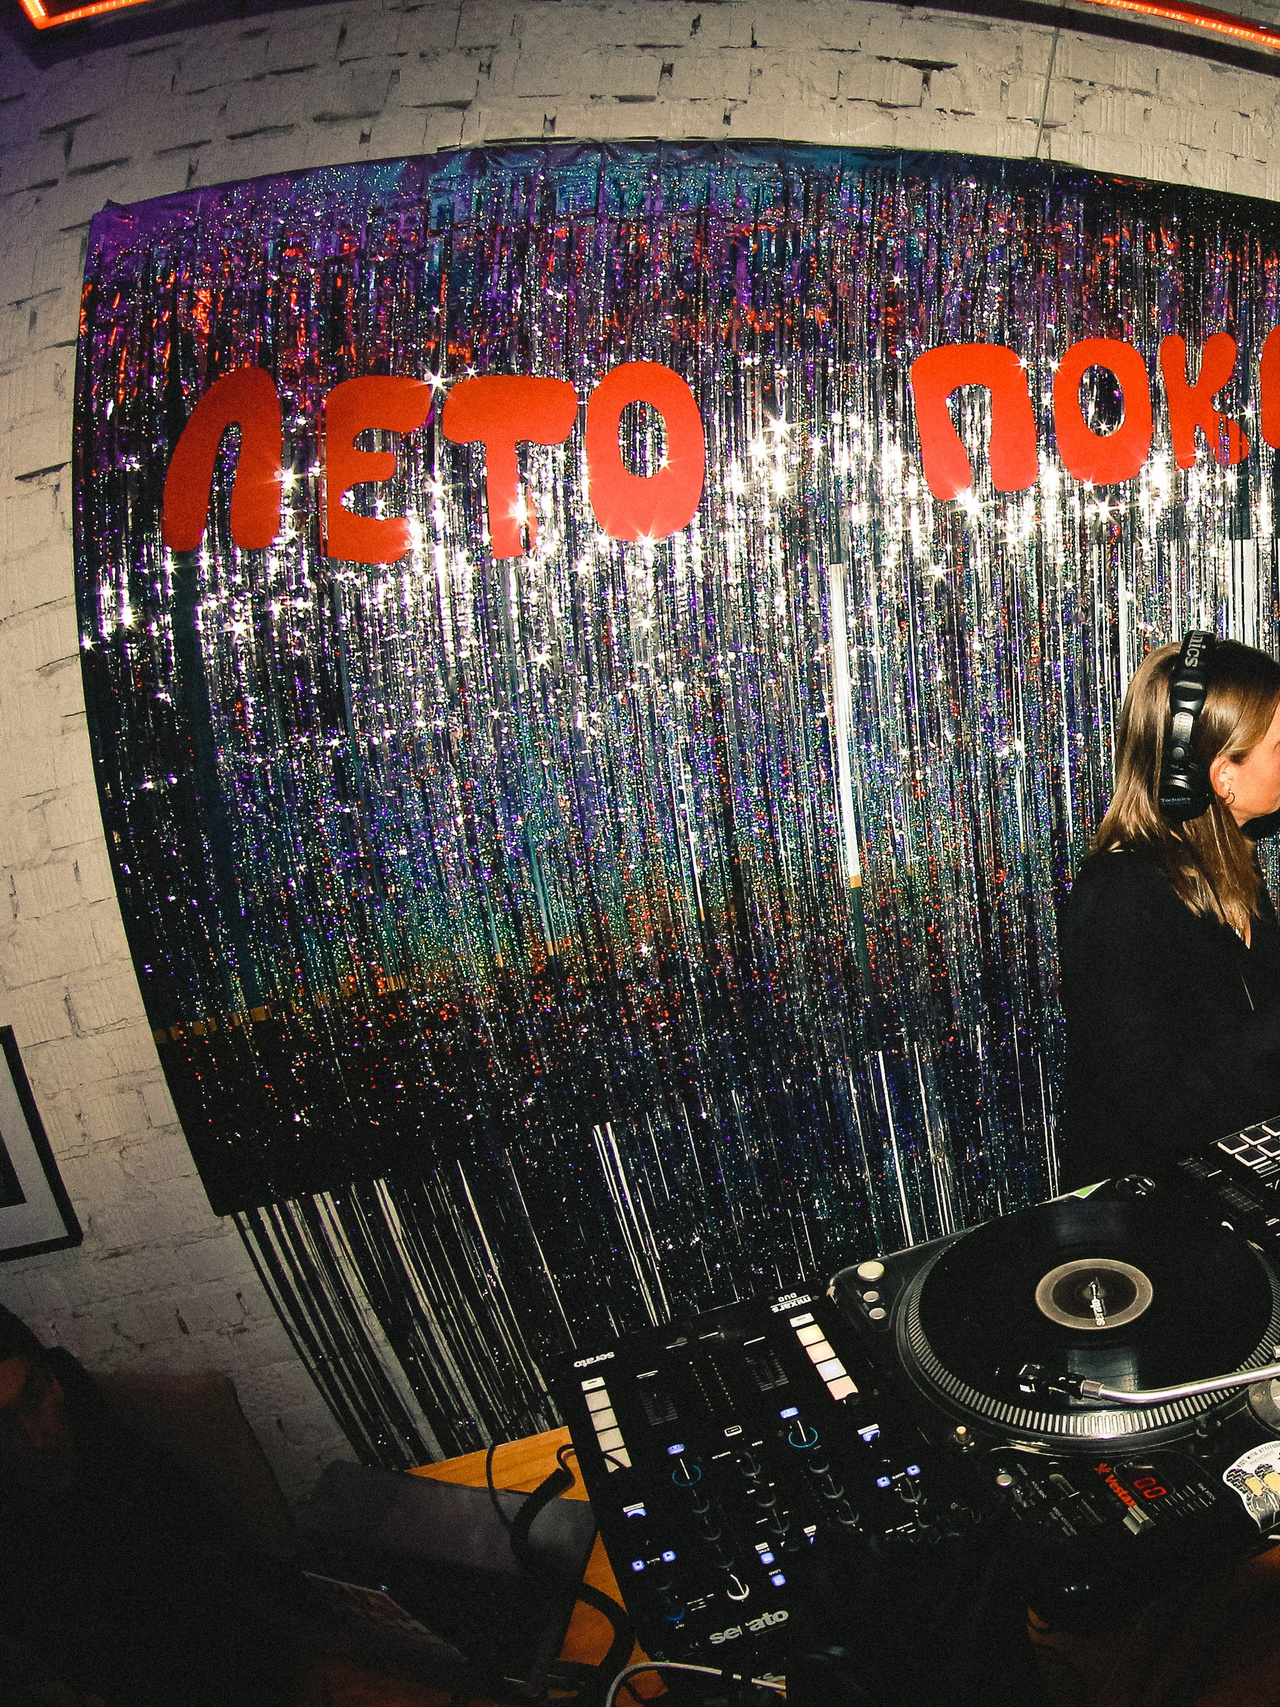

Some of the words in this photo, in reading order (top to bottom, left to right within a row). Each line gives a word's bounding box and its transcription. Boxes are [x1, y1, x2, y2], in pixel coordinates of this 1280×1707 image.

[162, 361, 704, 564] ЛЕТО
[771, 1295, 812, 1313] mixars
[573, 1351, 615, 1369] serato
[1105, 1474, 1137, 1508] Vestax
